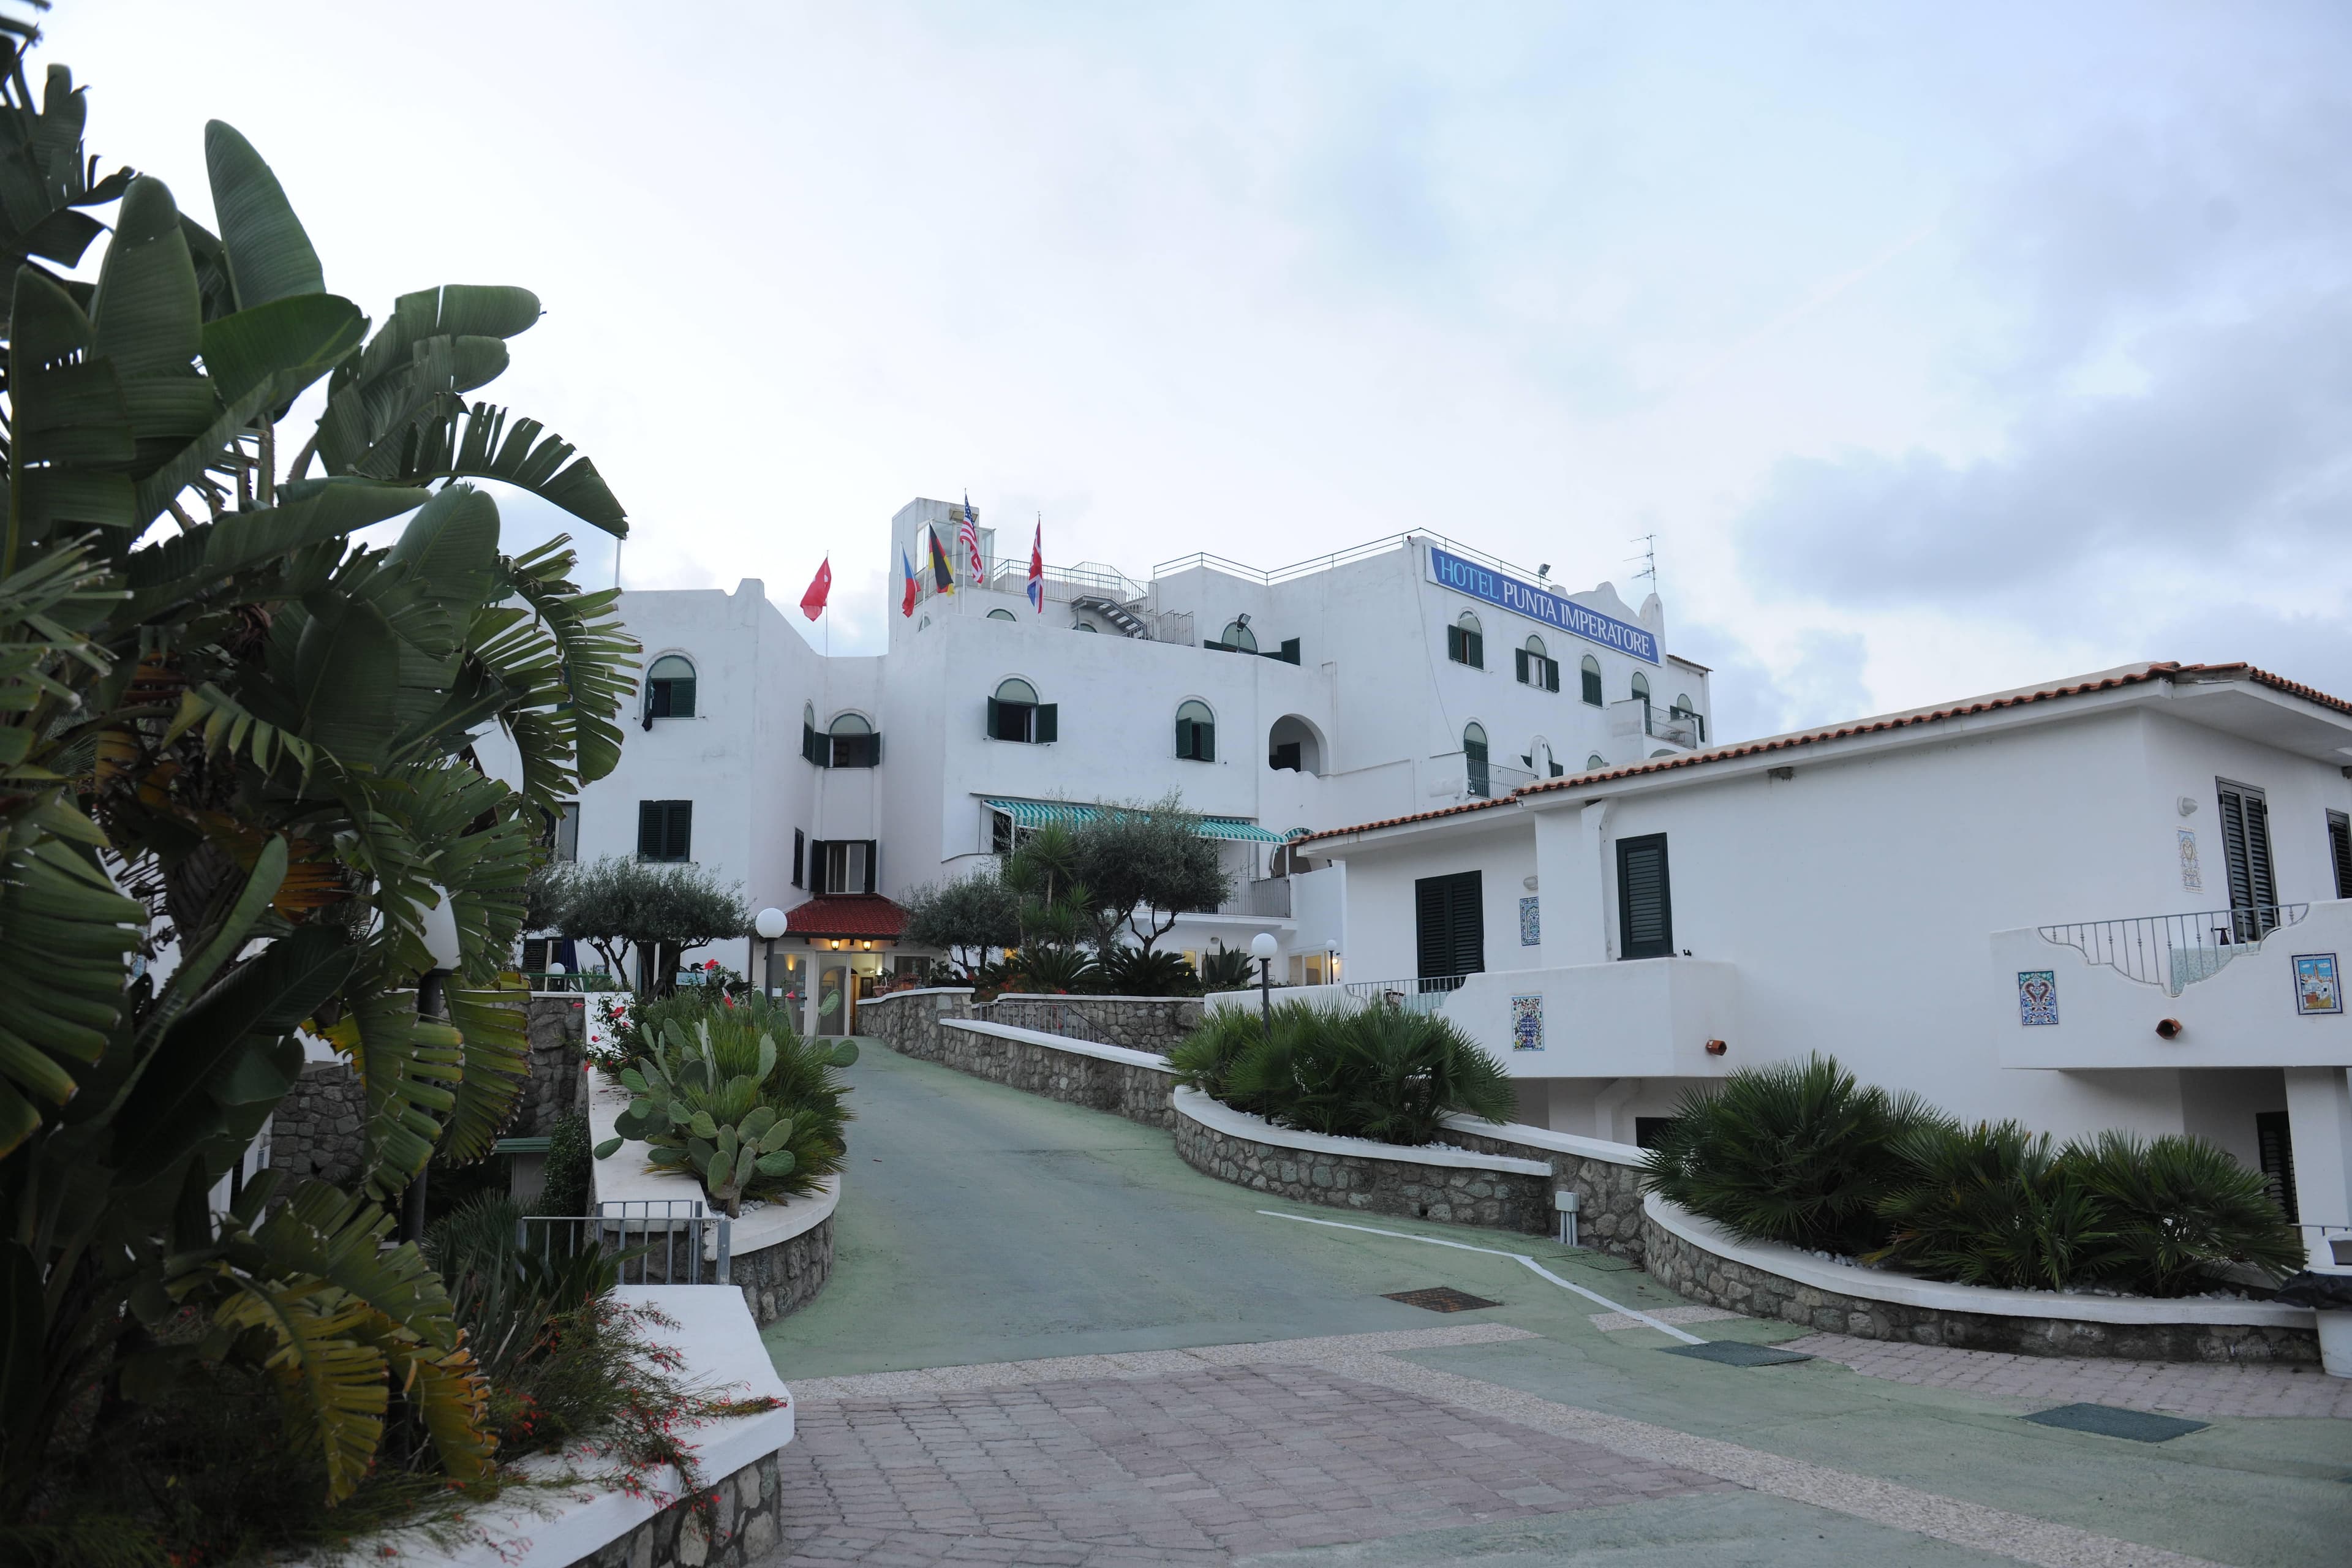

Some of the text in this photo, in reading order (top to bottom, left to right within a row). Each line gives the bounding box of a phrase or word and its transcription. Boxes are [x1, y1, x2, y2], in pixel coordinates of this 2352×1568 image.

[1439, 556, 1650, 656] HOTEL PUNTA IMPERATORE
